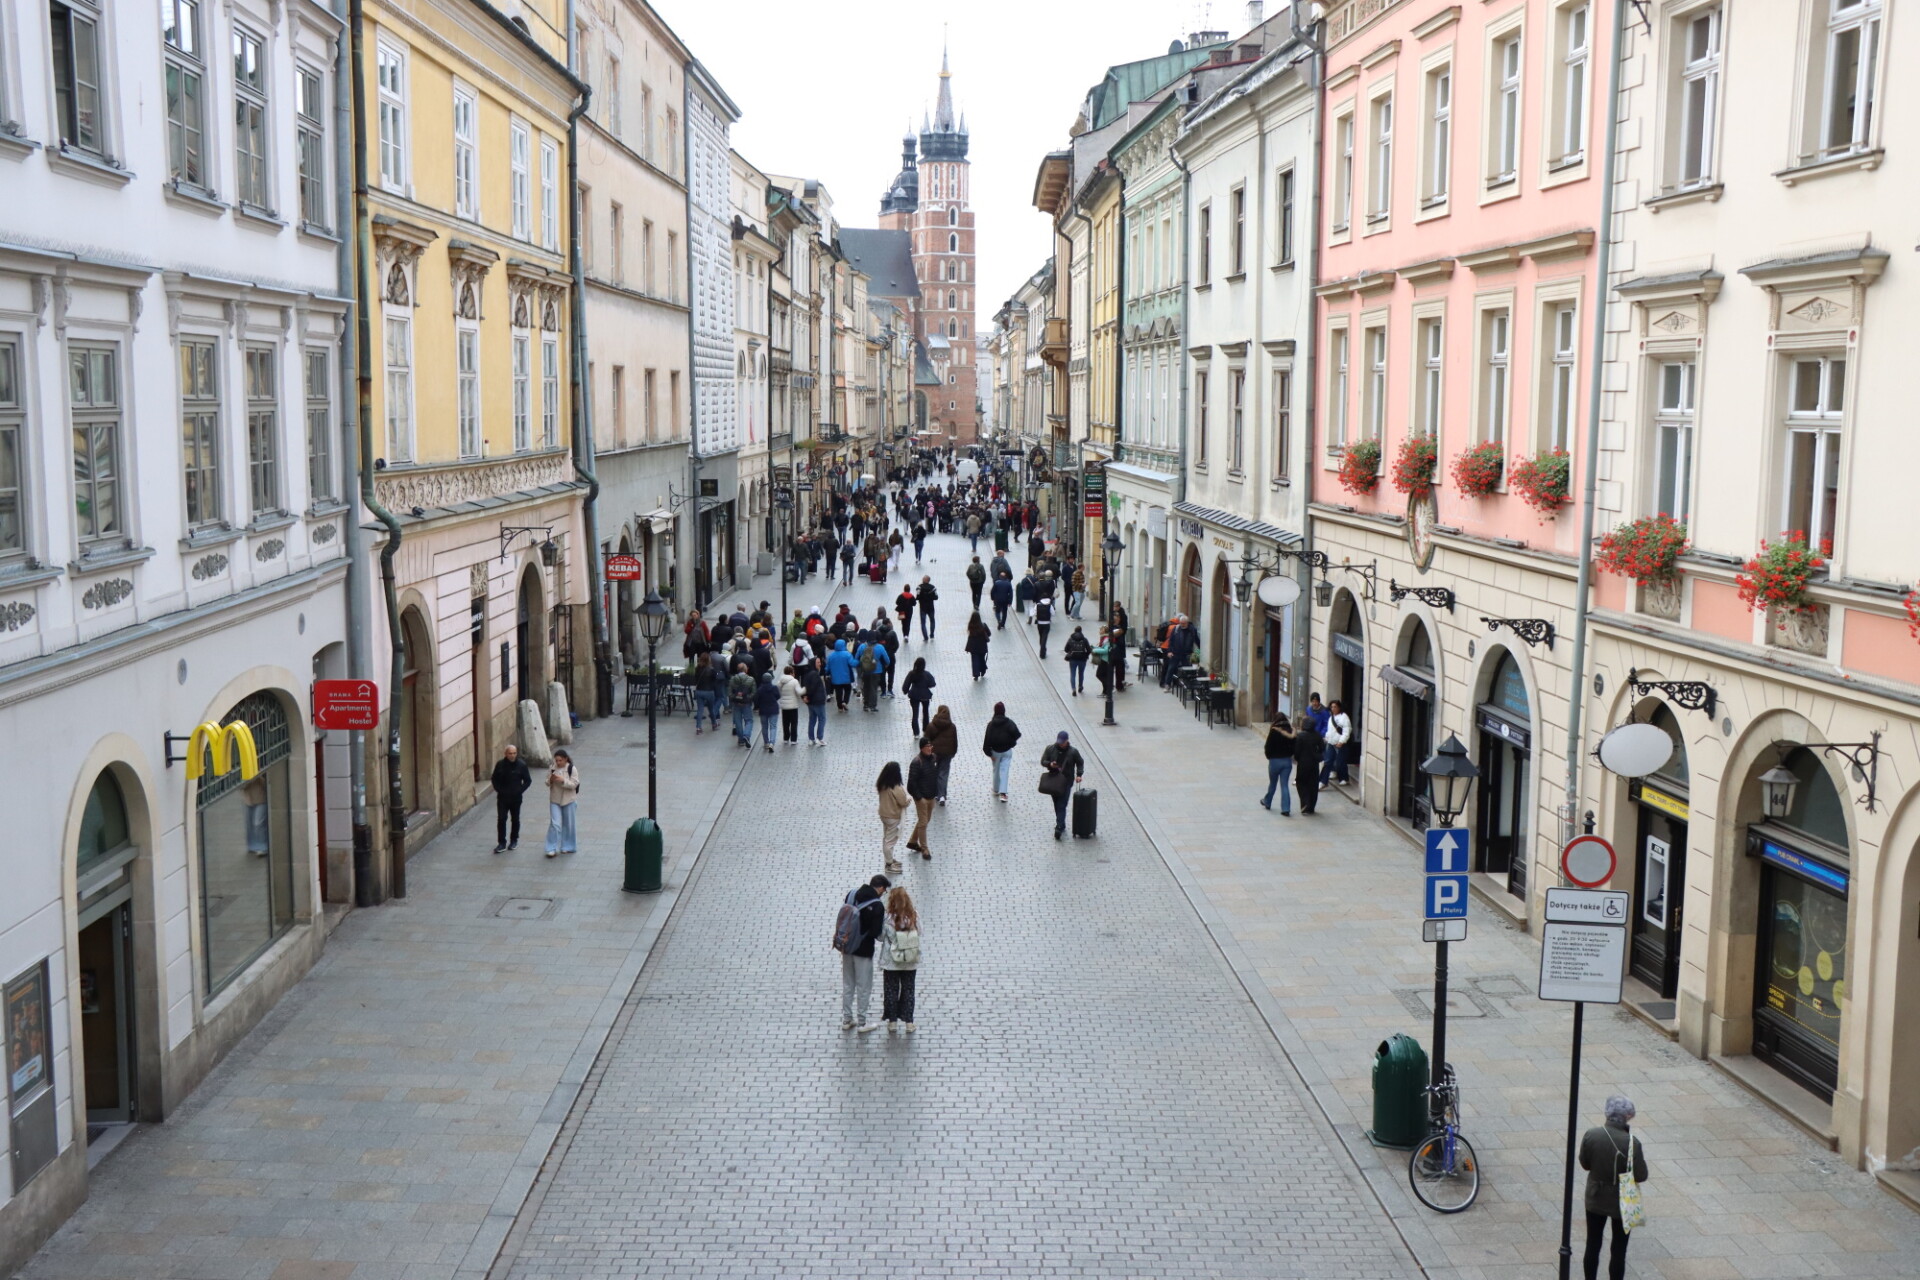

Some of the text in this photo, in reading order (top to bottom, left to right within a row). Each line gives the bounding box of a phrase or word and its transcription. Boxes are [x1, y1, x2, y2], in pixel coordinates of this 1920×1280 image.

[1772, 794, 1786, 805] 44
[1434, 880, 1460, 914] P
[1549, 901, 1600, 911] Dotyczy także
